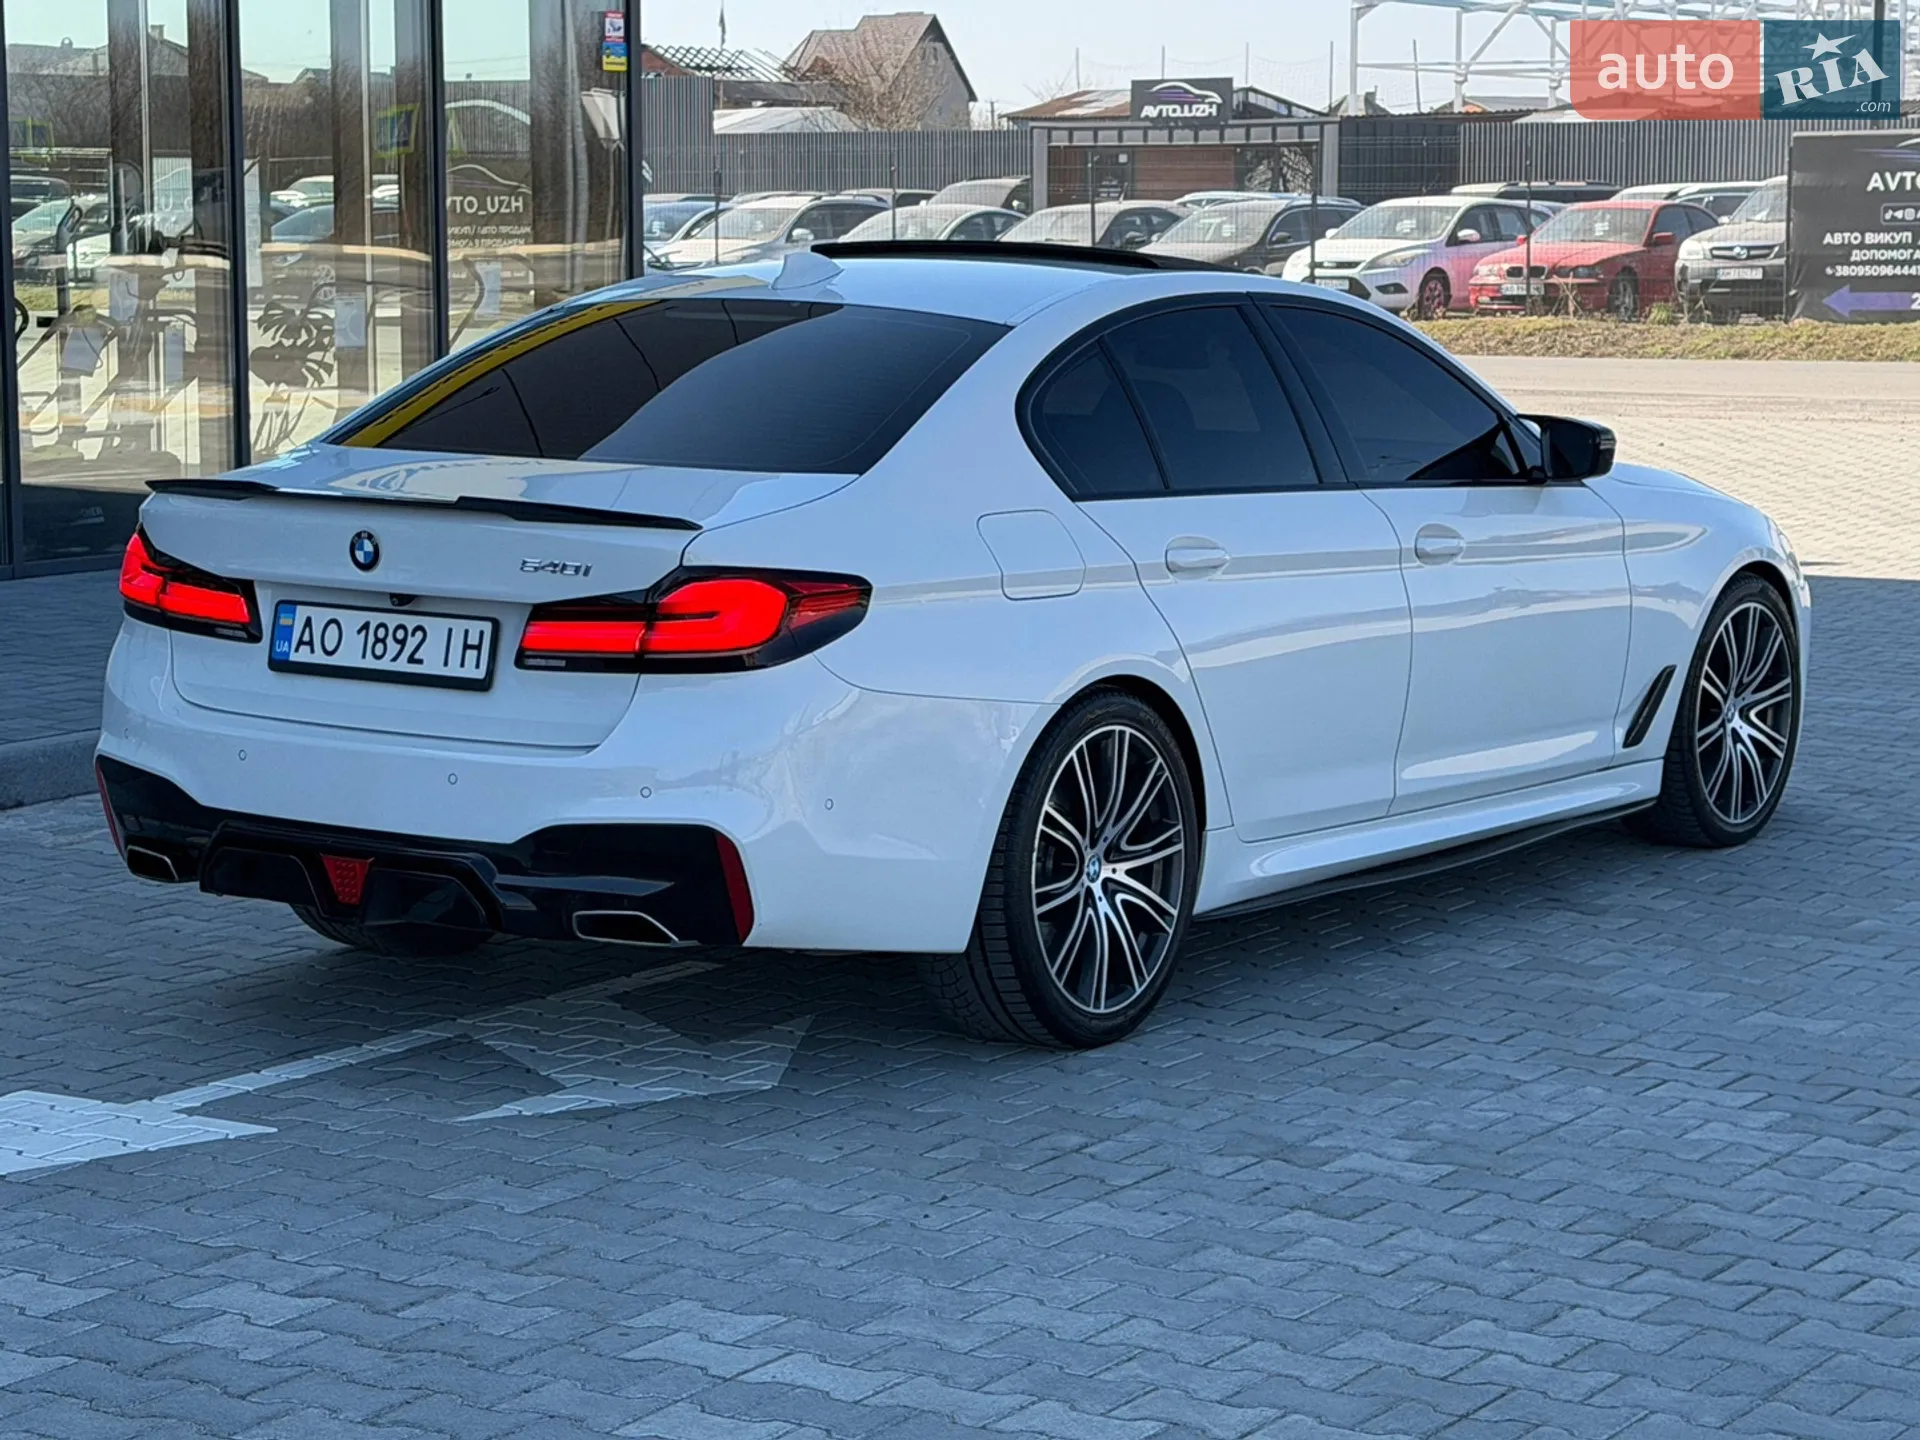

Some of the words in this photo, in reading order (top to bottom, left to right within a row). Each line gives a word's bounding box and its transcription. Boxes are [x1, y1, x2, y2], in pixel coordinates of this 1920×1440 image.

[1866, 171, 1920, 192] AVT
[1823, 232, 1861, 245] АВТО
[1864, 231, 1912, 245] ВИКУП
[275, 640, 290, 653] UA
[294, 616, 343, 657] AO
[356, 620, 428, 666] 1892
[442, 627, 485, 670] IH
